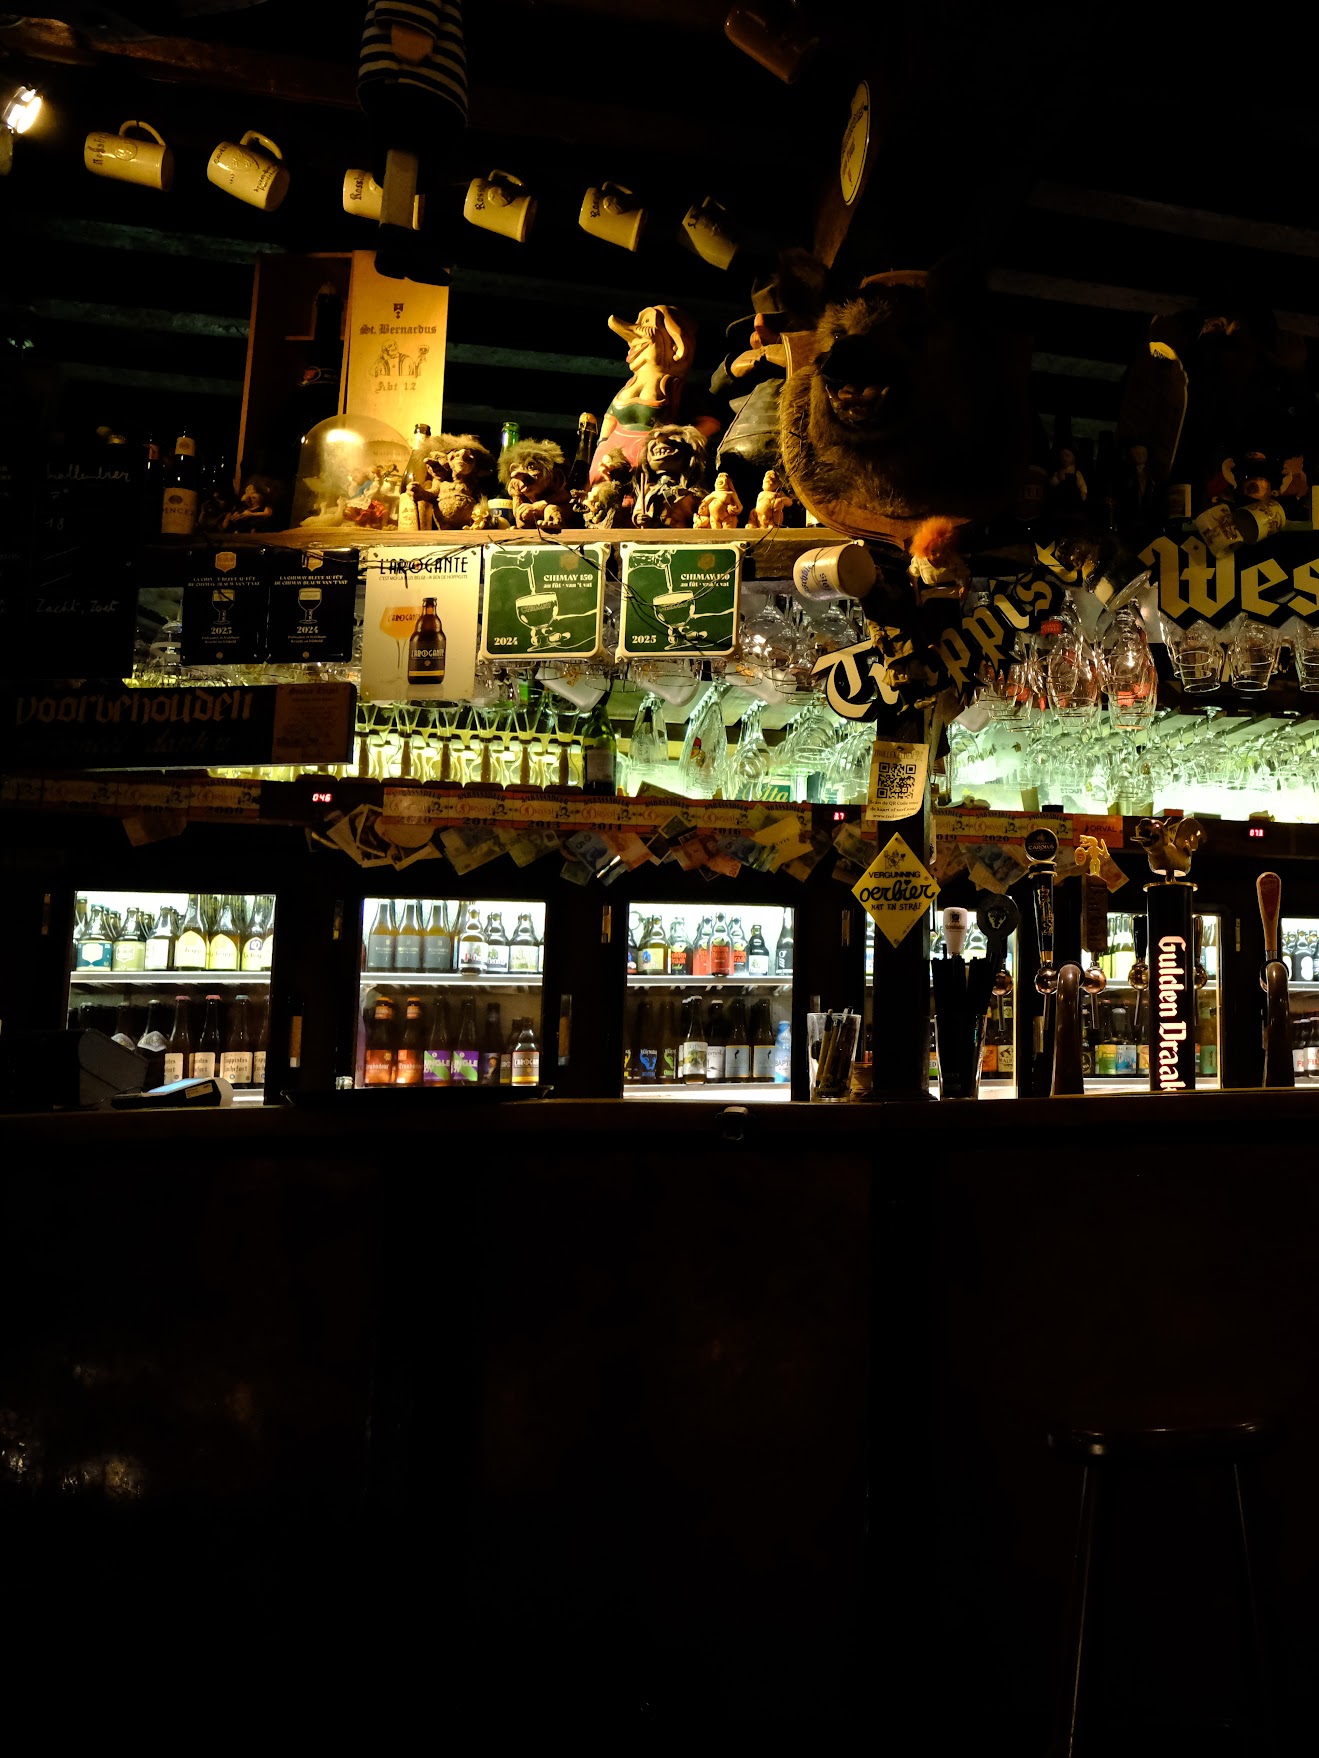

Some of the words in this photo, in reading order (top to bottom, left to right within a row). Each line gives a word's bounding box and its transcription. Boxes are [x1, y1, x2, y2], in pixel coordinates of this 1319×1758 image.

[359, 324, 377, 335] St.
[380, 324, 437, 335] Bernardus
[404, 381, 417, 391] 12
[380, 556, 469, 575] L'AROGANTE
[543, 574, 579, 582] CHIMAY
[580, 573, 594, 582] 150
[680, 573, 715, 582] CHIMAY
[715, 573, 731, 581] 150
[552, 581, 562, 589] fût
[210, 626, 233, 635] 2025
[296, 625, 319, 634] 2024
[494, 636, 518, 647] 2024
[632, 635, 657, 644] 2025
[16, 687, 255, 727] voorbehouden
[457, 792, 506, 801] AMBASSADEUR
[521, 794, 569, 805] AMBASSADEUR
[704, 803, 749, 812] AMBASSADEUR
[462, 817, 498, 825] 2012
[527, 820, 561, 829] 2013
[591, 823, 622, 831] 2014
[1089, 825, 1117, 833] ORVAL
[981, 835, 1010, 843] 2020
[868, 870, 921, 879] VERGUNNING
[859, 879, 936, 903] oerbier
[870, 903, 886, 911] NAT
[899, 902, 922, 911] STRAF
[1158, 935, 1187, 1018] Gulden
